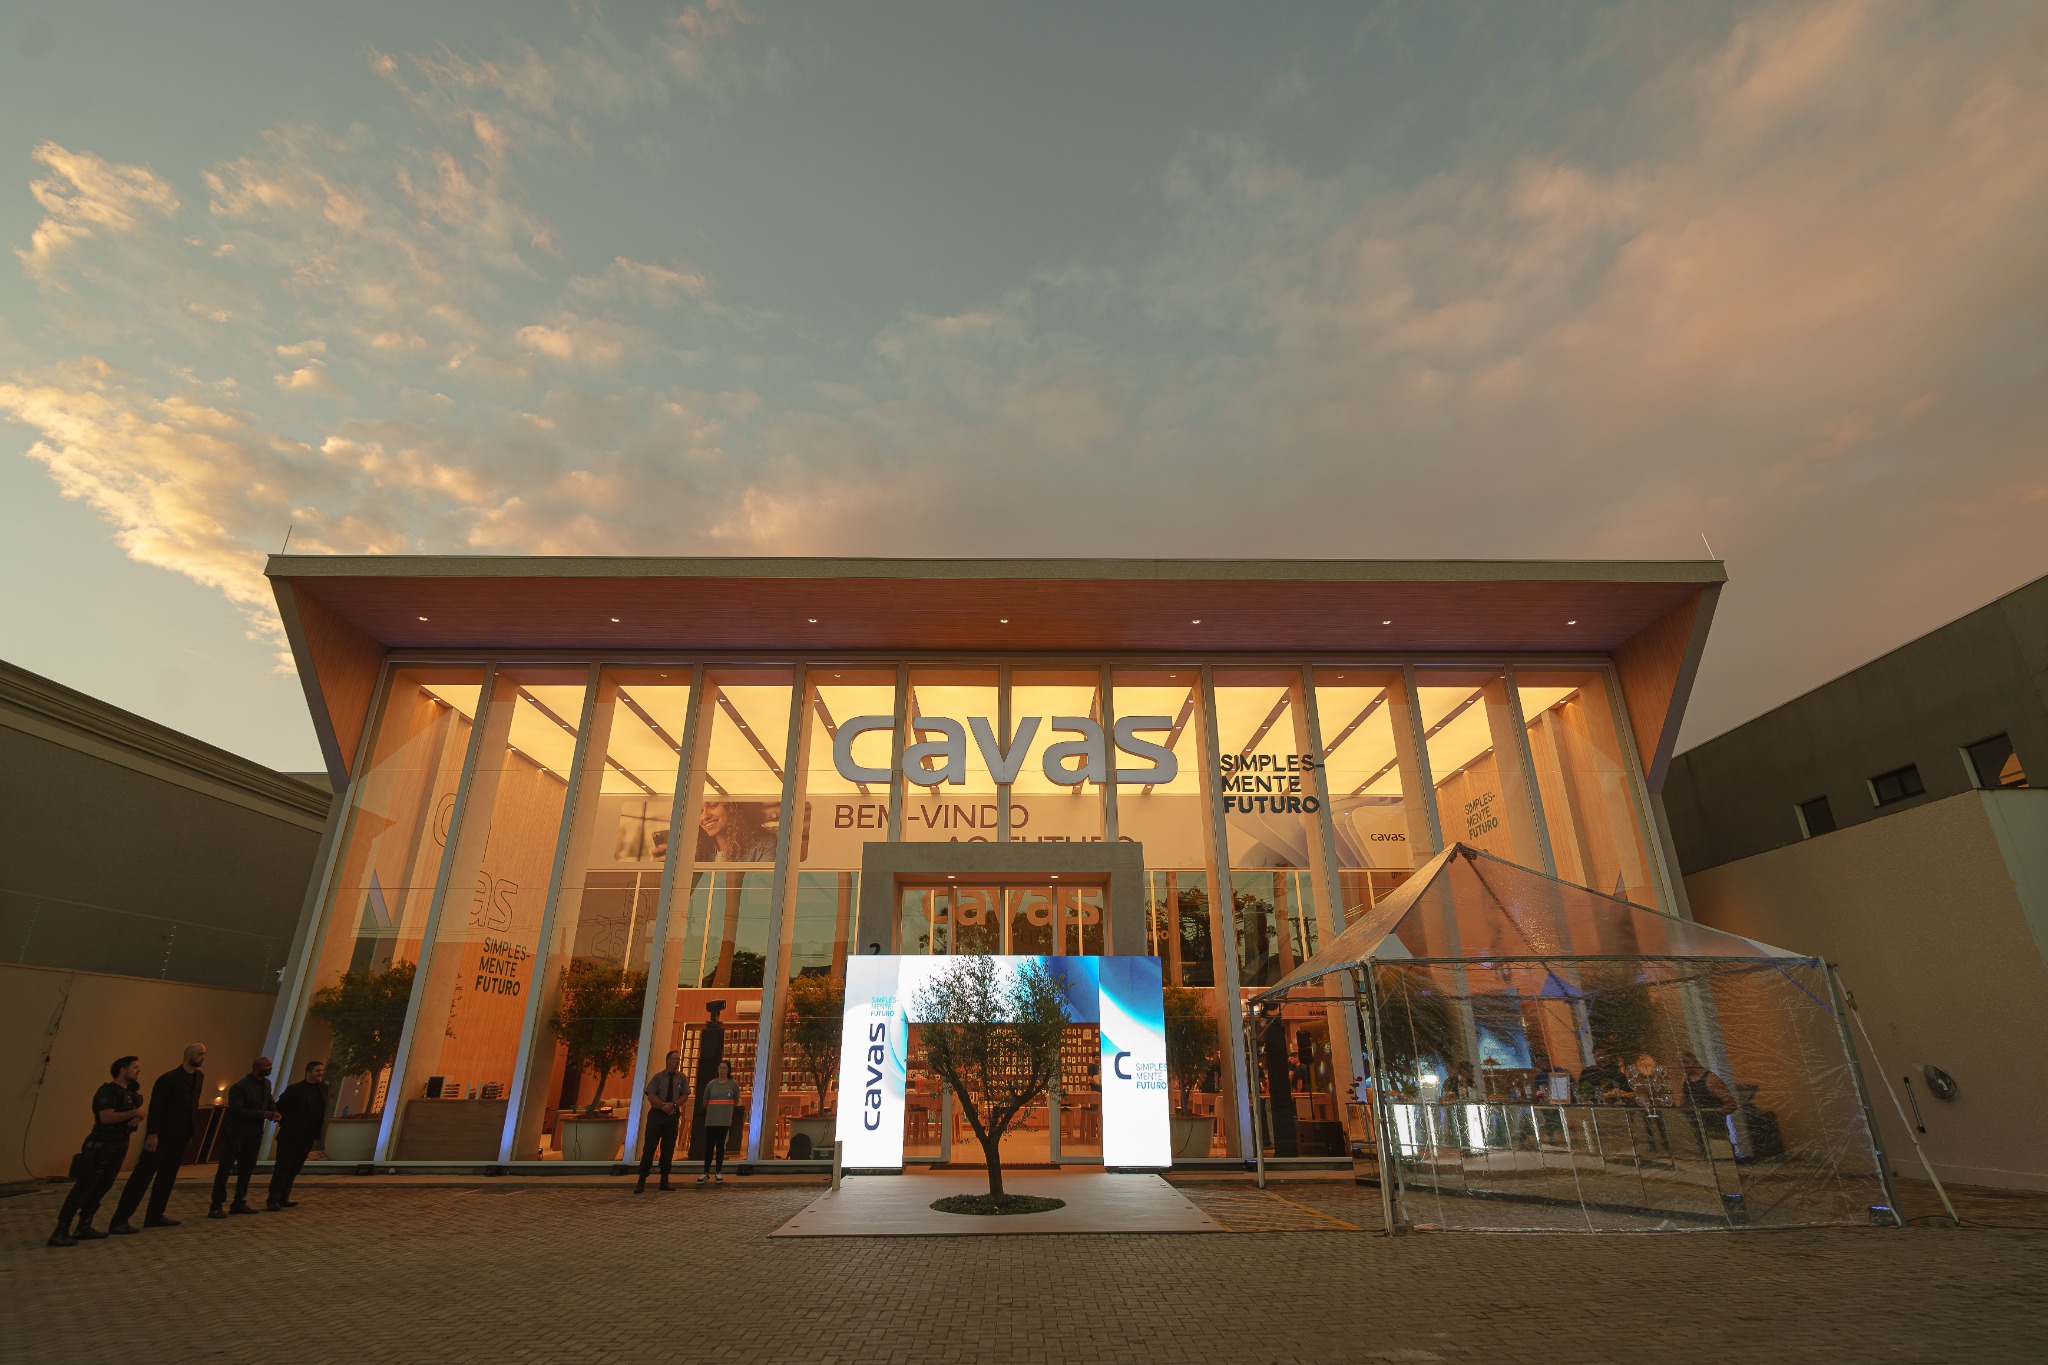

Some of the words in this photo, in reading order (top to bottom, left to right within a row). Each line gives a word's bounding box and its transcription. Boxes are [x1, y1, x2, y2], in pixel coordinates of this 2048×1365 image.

[833, 715, 1178, 786] cavas
[1220, 754, 1325, 772] SIMPLES-
[1221, 775, 1302, 793] MENTE
[1223, 796, 1320, 814] FUTURO
[1466, 805, 1492, 828] MENTE
[1370, 832, 1406, 842] cavas
[1468, 816, 1499, 841] FUTURO
[483, 936, 531, 961] SIMPLES-
[478, 955, 518, 978] MENTE
[474, 974, 521, 996] FUTURO
[864, 1022, 886, 1131] cavas
[1136, 1072, 1163, 1081] MENTE
[1136, 1081, 1168, 1090] FUTURO
